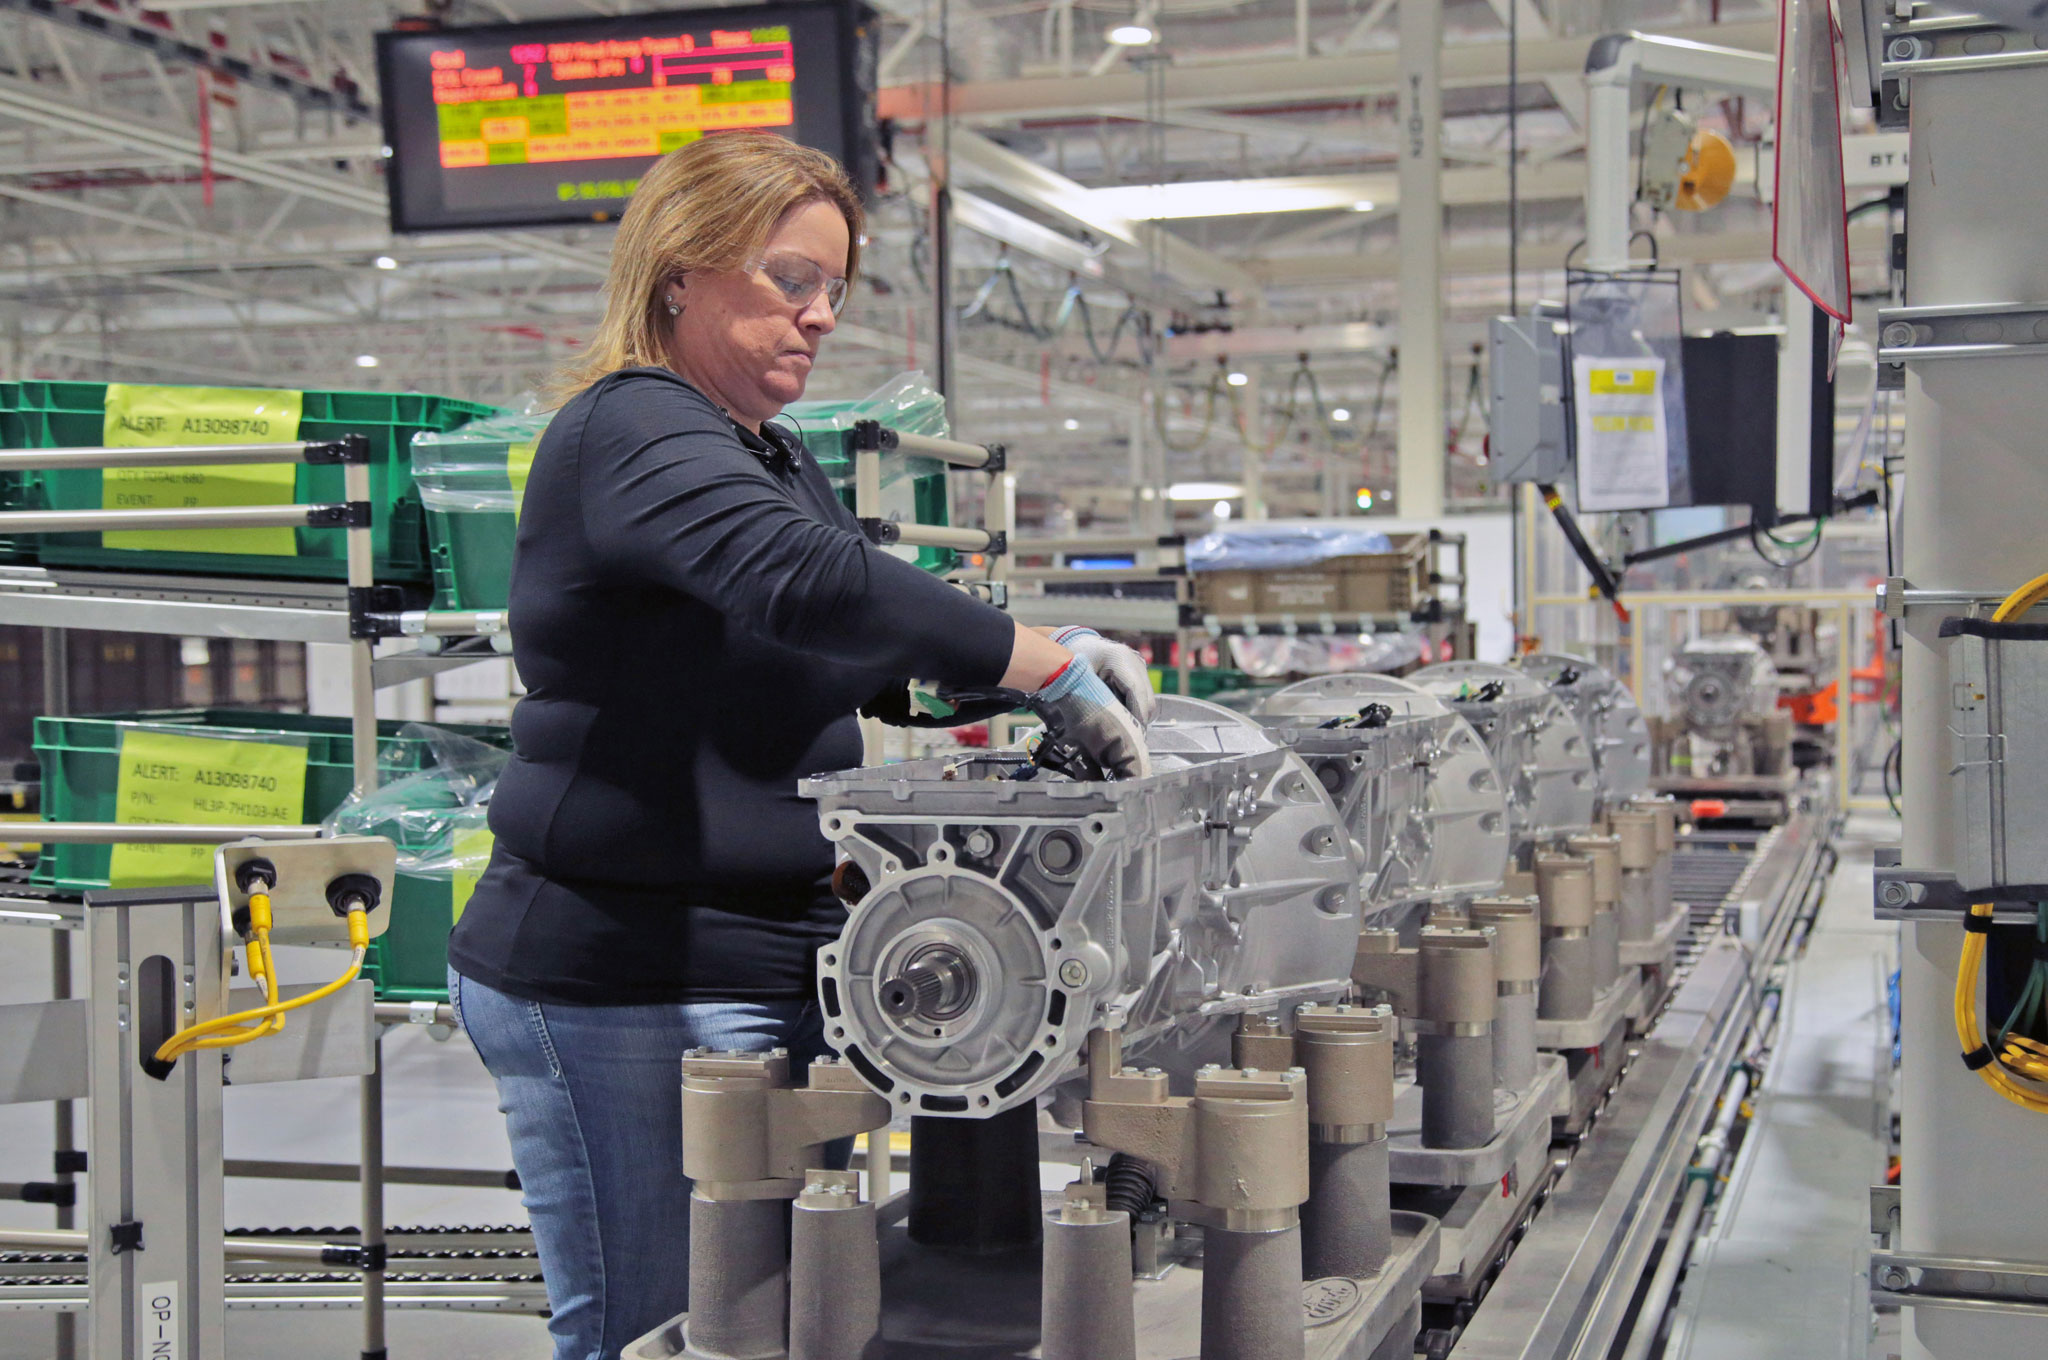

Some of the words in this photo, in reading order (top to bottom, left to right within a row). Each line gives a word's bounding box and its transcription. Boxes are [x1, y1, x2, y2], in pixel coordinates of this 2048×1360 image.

[118, 416, 167, 432] ALERT:
[182, 417, 269, 436] A13098740
[133, 763, 179, 782] ALERT:
[194, 769, 277, 793] A13098740
